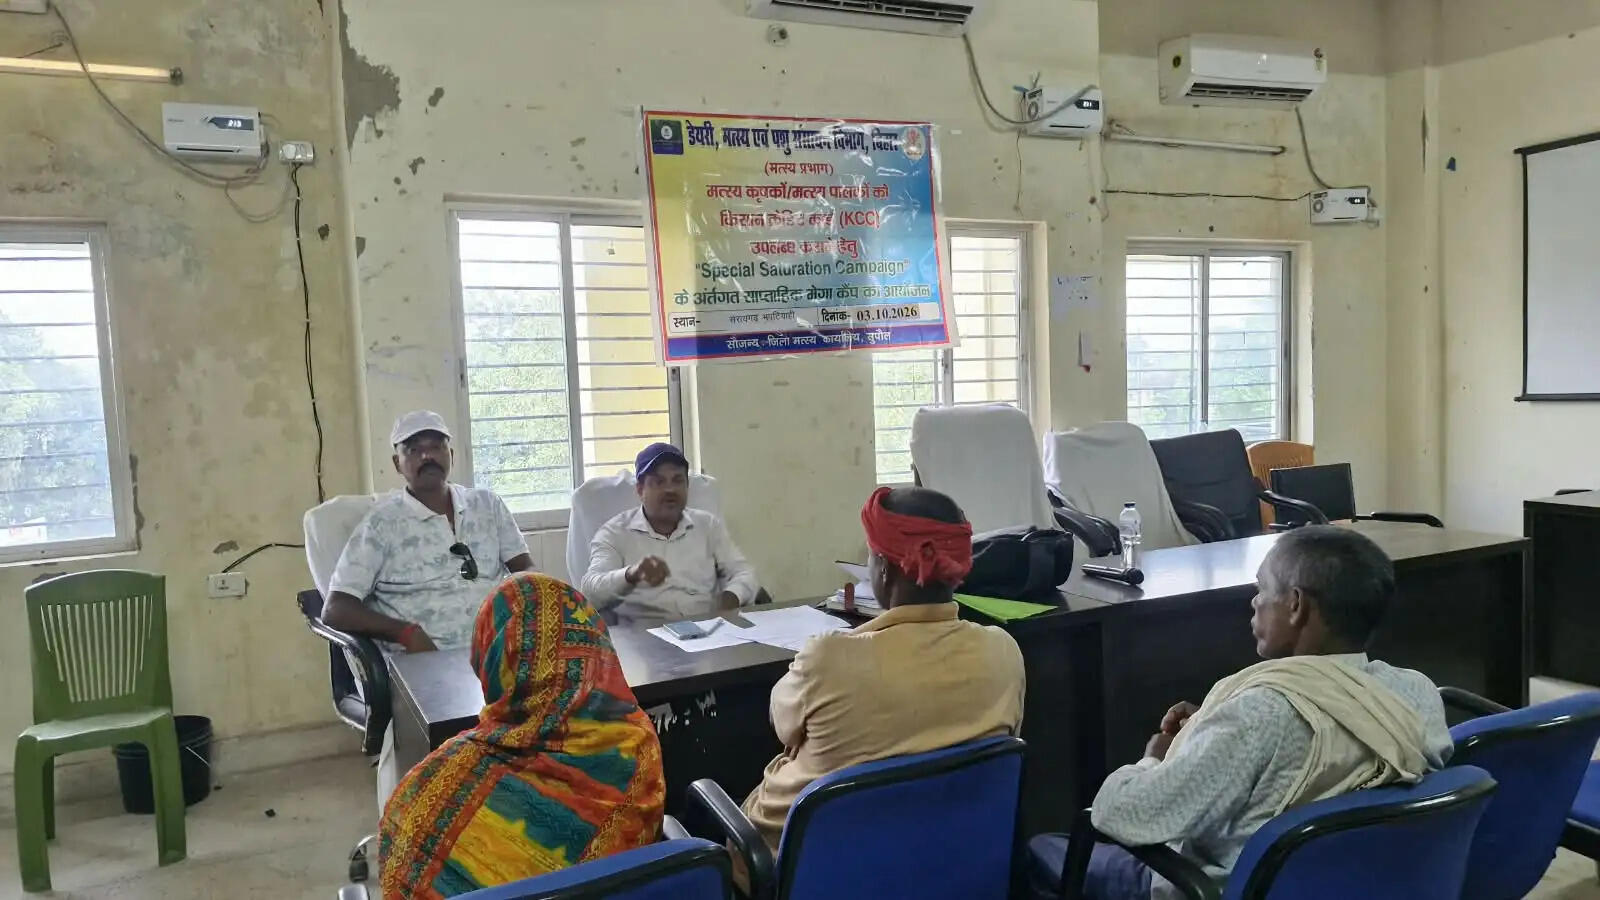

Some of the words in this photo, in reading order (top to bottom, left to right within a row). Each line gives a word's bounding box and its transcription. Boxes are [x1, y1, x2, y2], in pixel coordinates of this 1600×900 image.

[722, 128, 750, 147] मत्स्य
[751, 123, 769, 148] एवं
[765, 161, 796, 176] (मत्स्य
[800, 162, 834, 176] प्रभाग)
[706, 184, 742, 199] मत्स्य
[873, 183, 889, 199] को
[839, 210, 880, 229] (KCC)
[759, 260, 832, 277] Saturation
[673, 289, 690, 305] के
[806, 285, 833, 300] मेगा
[863, 285, 881, 299] का
[856, 306, 918, 321] 03.10.2026
